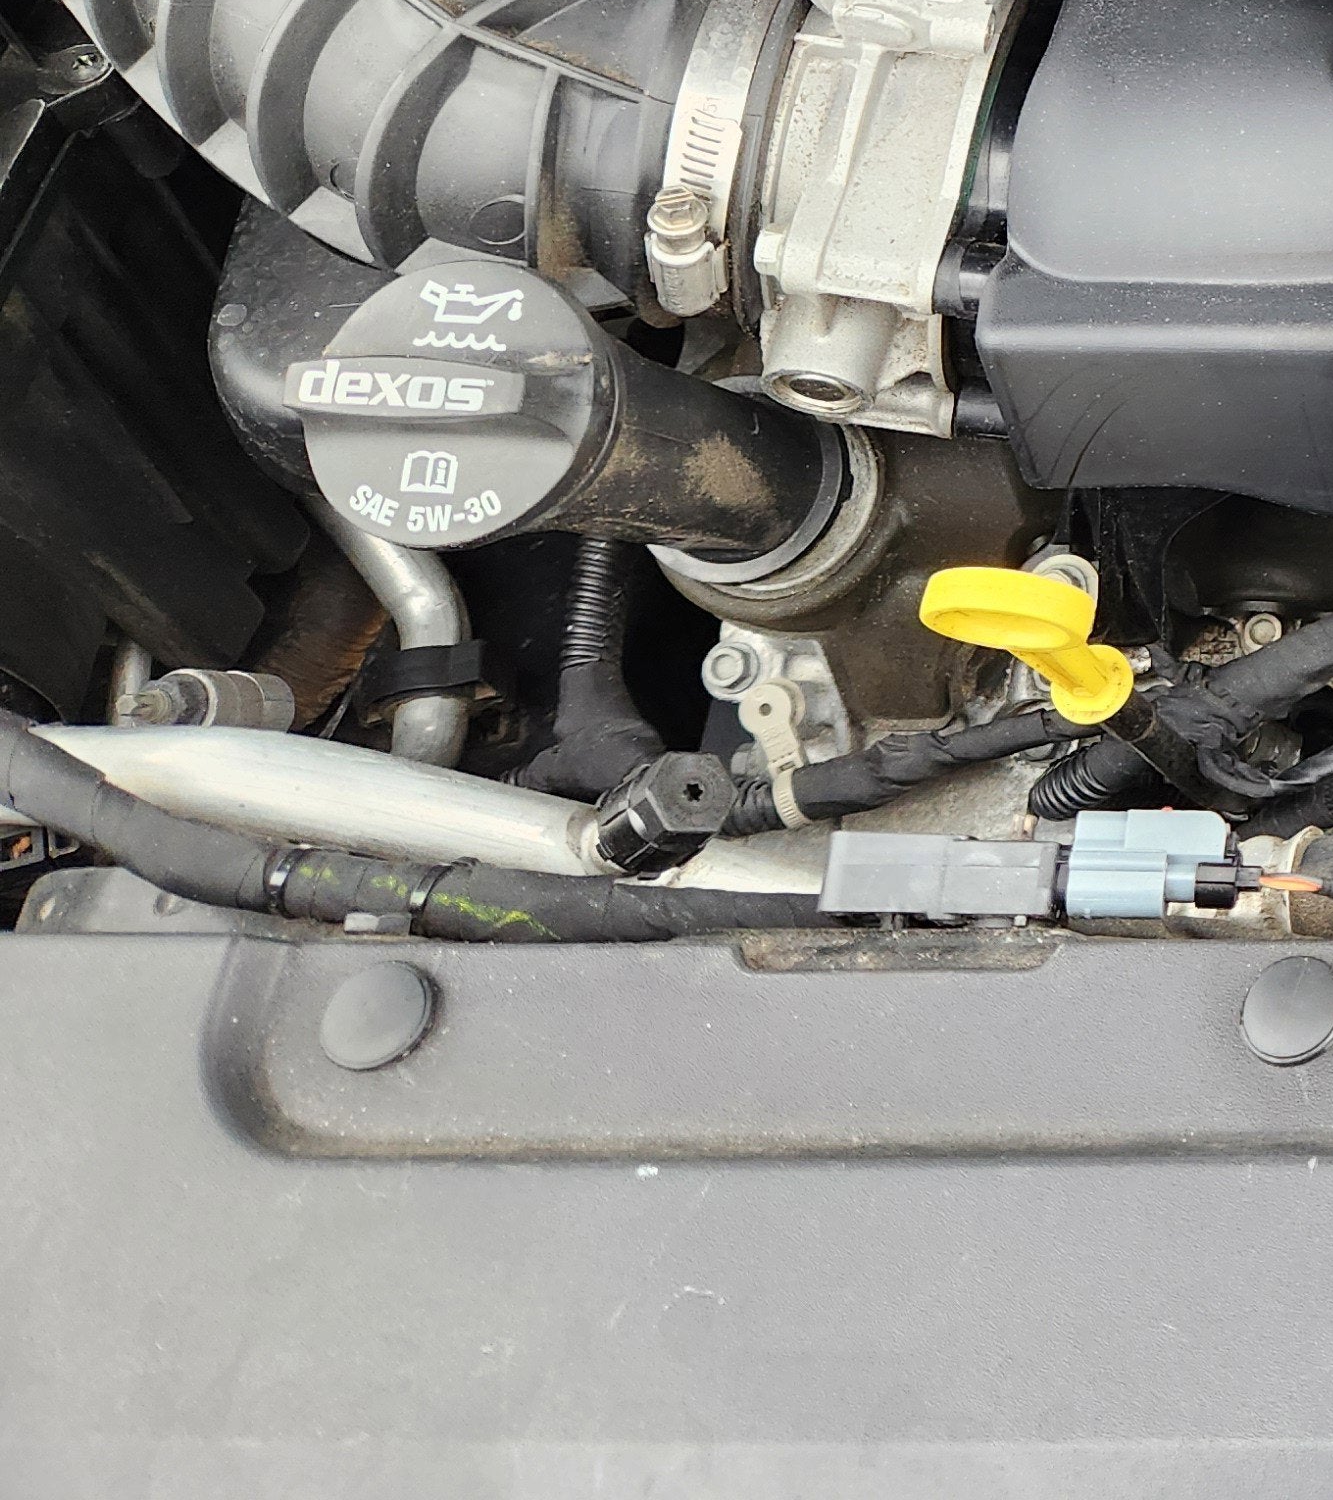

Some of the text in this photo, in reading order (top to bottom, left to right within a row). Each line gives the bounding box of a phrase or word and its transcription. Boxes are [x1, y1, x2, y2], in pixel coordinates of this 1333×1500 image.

[299, 359, 486, 412] dexos
[349, 484, 502, 533] SAE 5W-30
